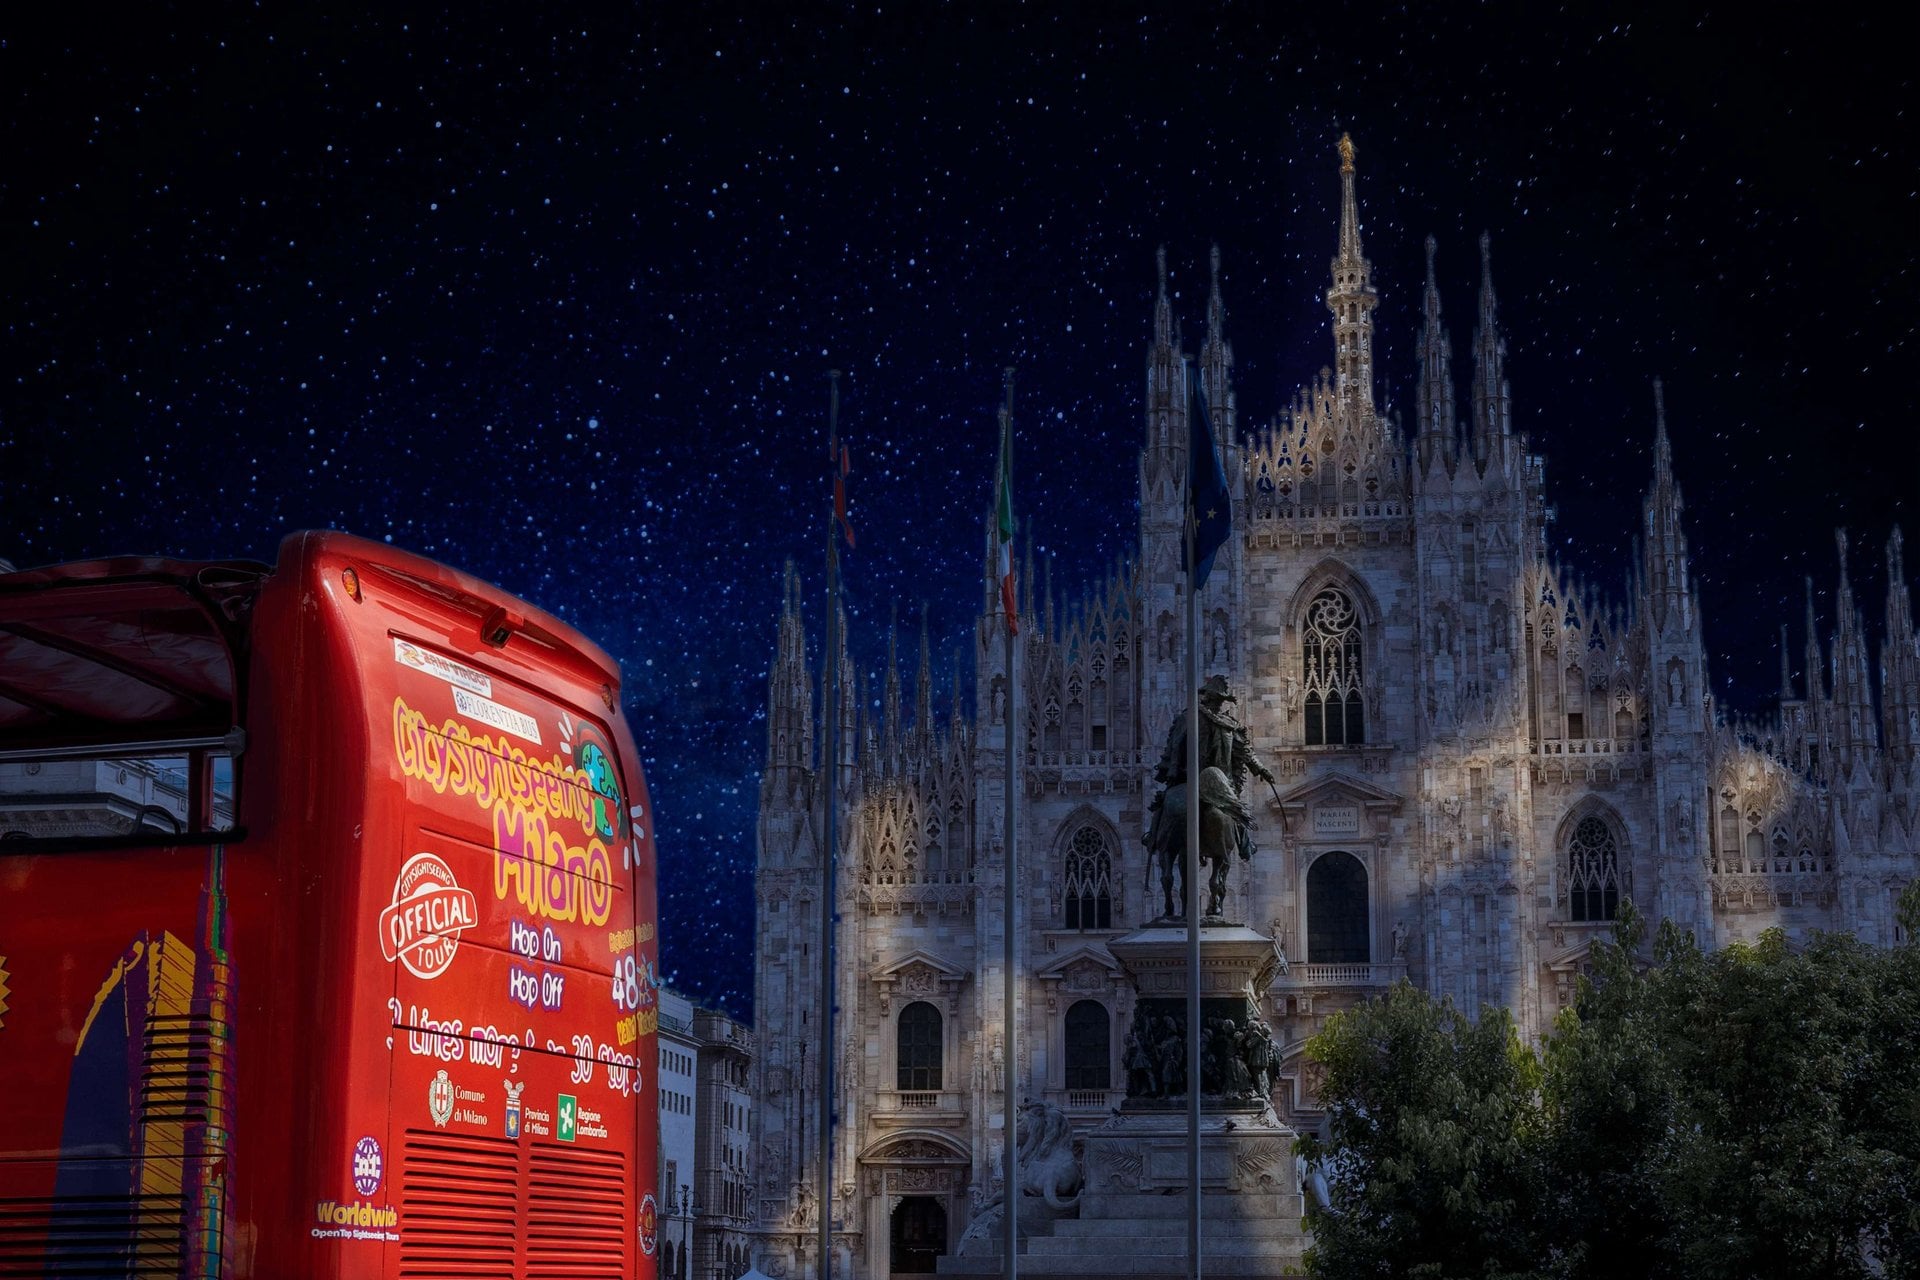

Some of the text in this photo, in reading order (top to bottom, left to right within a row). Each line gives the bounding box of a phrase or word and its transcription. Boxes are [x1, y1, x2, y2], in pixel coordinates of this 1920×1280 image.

[465, 695, 538, 739] FLORENTIA BUS
[400, 862, 451, 896] CITYSIGHTSEEING
[493, 800, 612, 927] Milano
[390, 895, 472, 948] OFFICIAL
[417, 936, 455, 969] TOUR
[512, 921, 561, 962] Hop On
[510, 968, 564, 1008] Hop Off
[612, 955, 639, 1010] 48
[409, 1005, 465, 1062] Lines
[571, 1034, 593, 1084] 30
[454, 1085, 485, 1103] Comune
[454, 1109, 488, 1126] di Milano
[524, 1107, 550, 1122] Provincia
[524, 1121, 549, 1136] di Milano
[577, 1107, 601, 1122] Regione
[577, 1122, 608, 1138] Lombardia
